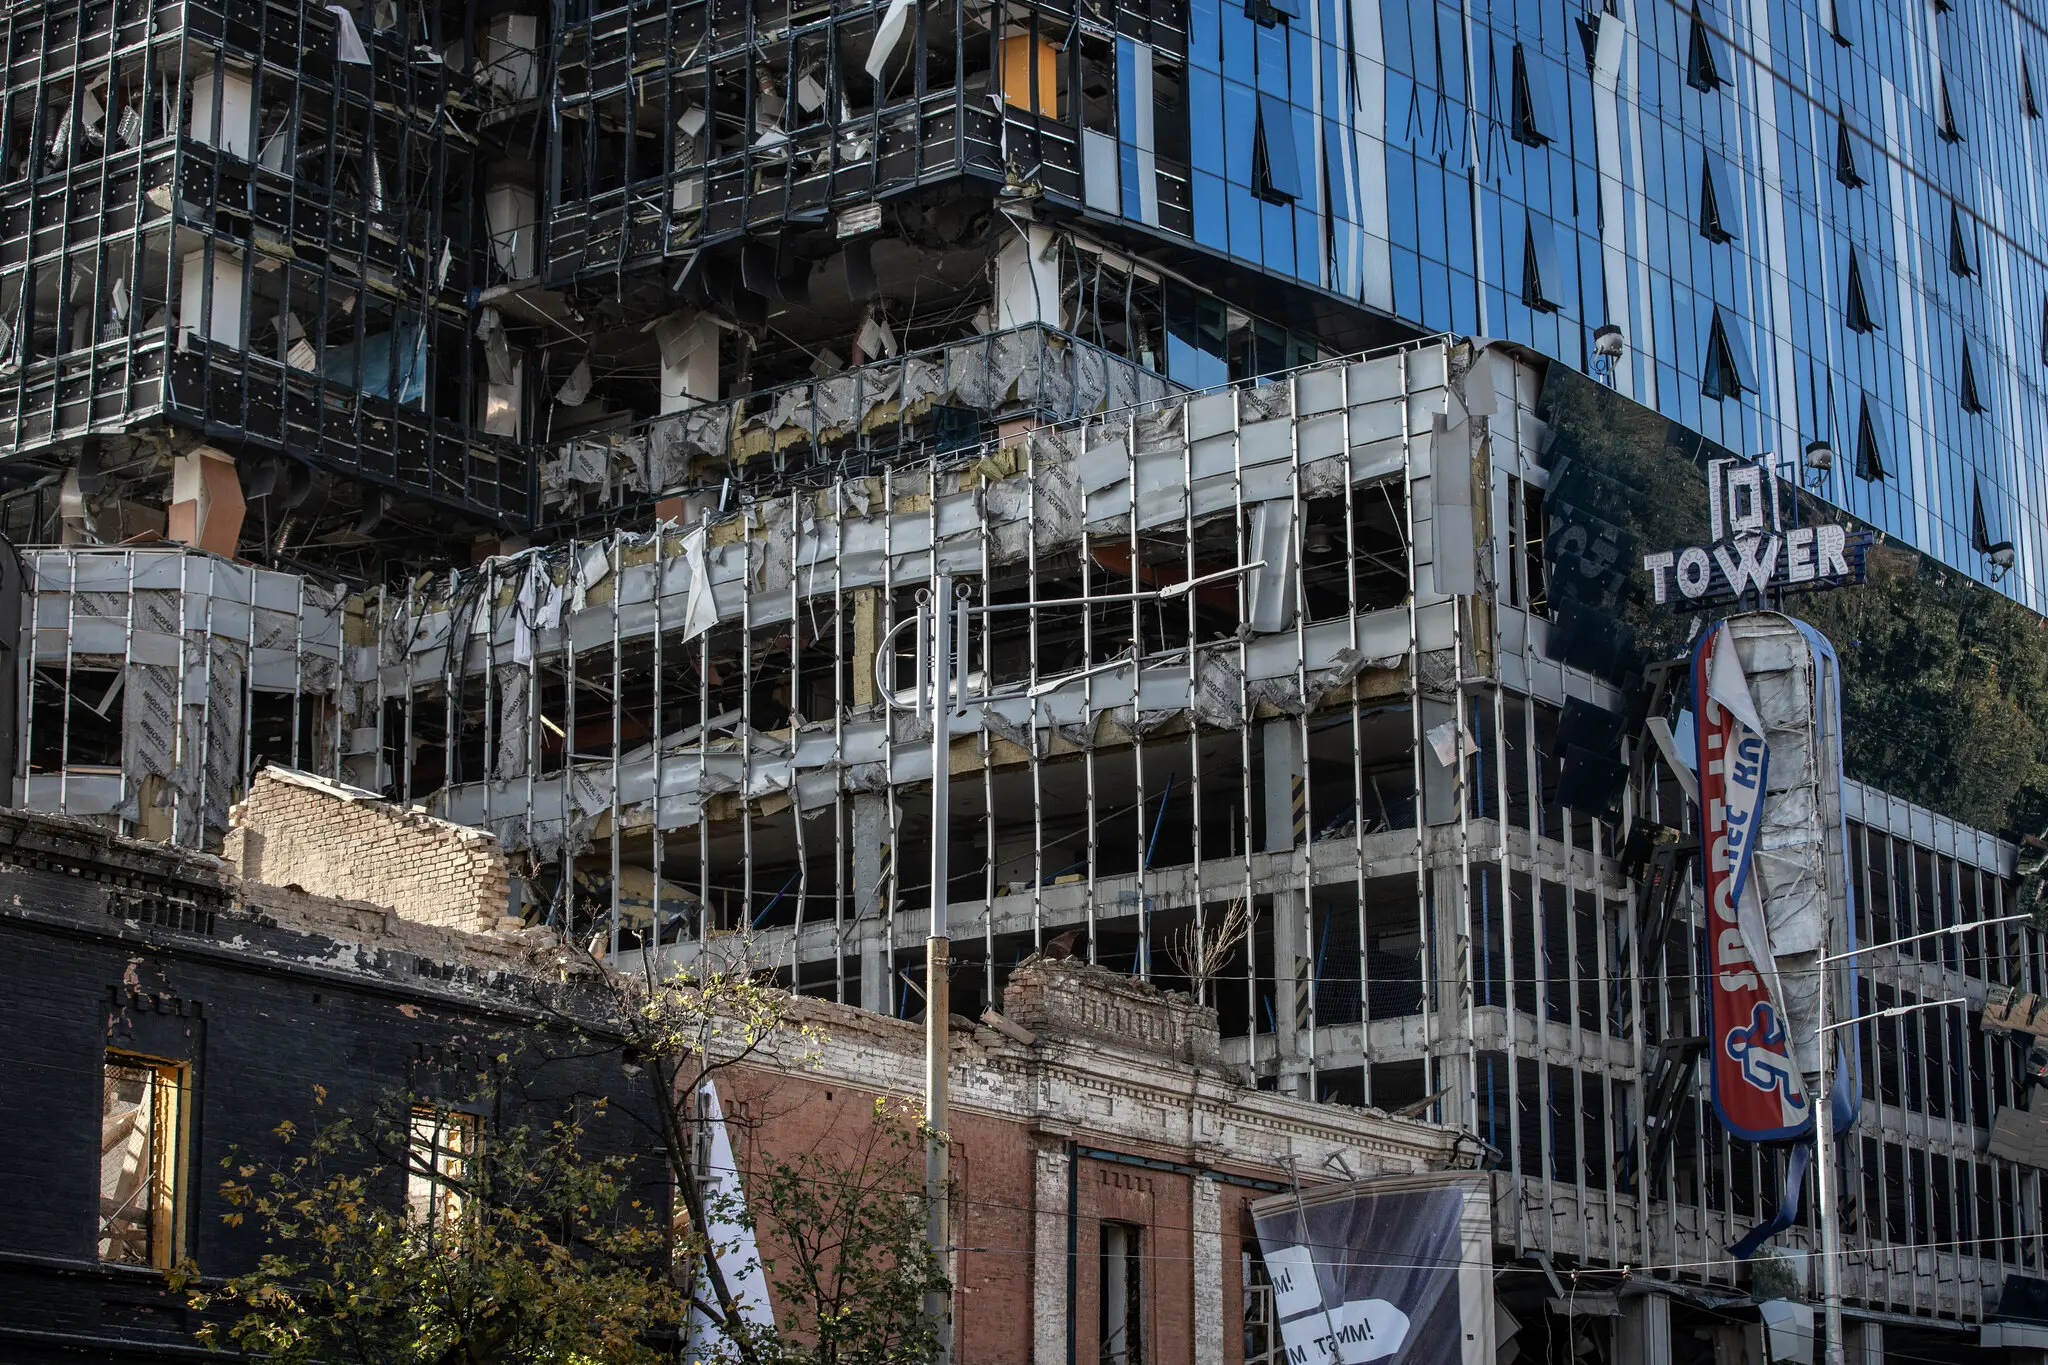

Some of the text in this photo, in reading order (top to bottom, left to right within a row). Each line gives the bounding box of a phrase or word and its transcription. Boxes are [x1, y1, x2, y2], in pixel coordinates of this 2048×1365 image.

[1049, 436, 1073, 460] WIGOFO
[1034, 484, 1047, 498] 100
[1644, 523, 1849, 604] TOWER
[148, 605, 176, 634] WIGOFOL
[143, 690, 170, 722] WIGOFOL
[223, 694, 234, 708] 100
[141, 719, 168, 750] WIGOFOL
[505, 747, 514, 759] 100
